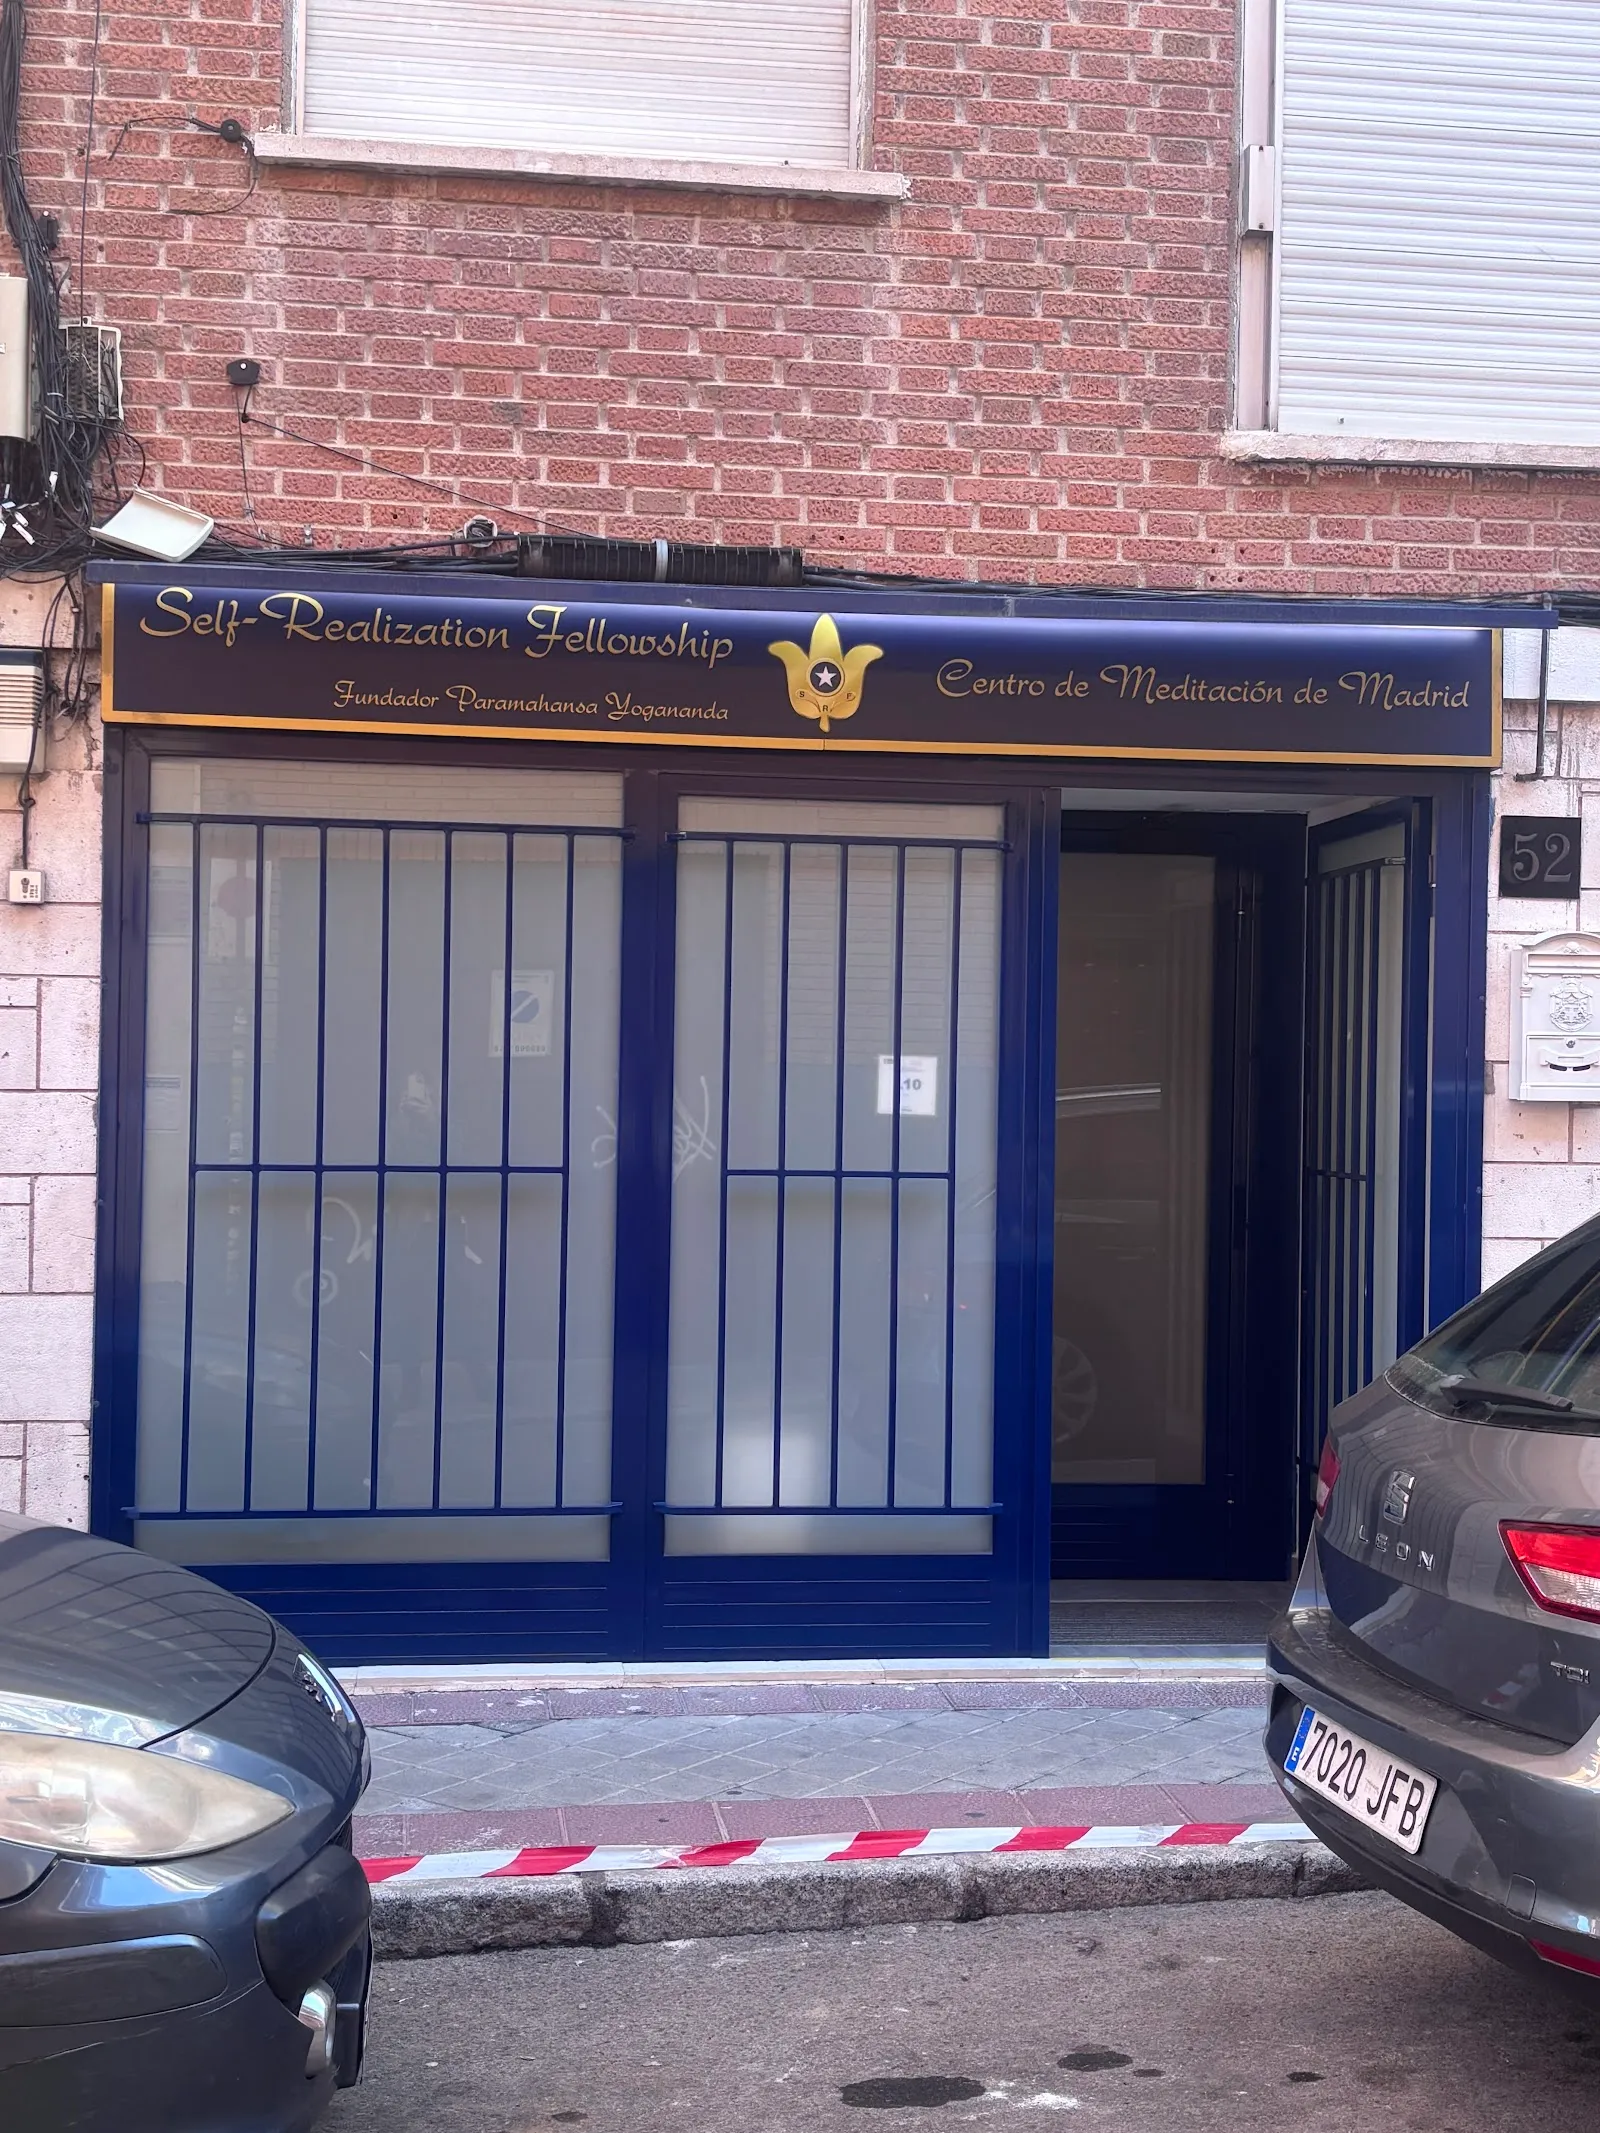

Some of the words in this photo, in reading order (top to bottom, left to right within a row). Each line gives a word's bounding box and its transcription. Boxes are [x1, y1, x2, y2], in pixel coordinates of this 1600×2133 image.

[140, 586, 510, 650] Self-Realization
[525, 604, 734, 668] Fellowship
[333, 680, 440, 708] Fundador
[446, 685, 599, 716] Paramahansa
[605, 693, 729, 721] Yogananda
[936, 659, 1044, 697] Centro
[1053, 670, 1089, 697] de
[1099, 664, 1283, 706] Meditación
[1293, 677, 1329, 705] de
[1338, 671, 1470, 710] Madrid
[1513, 833, 1572, 881] 52
[1358, 1524, 1435, 1571] LEON
[1550, 1661, 1589, 1684] TDI
[1291, 1746, 1300, 1762] E
[1302, 1720, 1366, 1802] 7020
[1366, 1764, 1425, 1837] JFB
